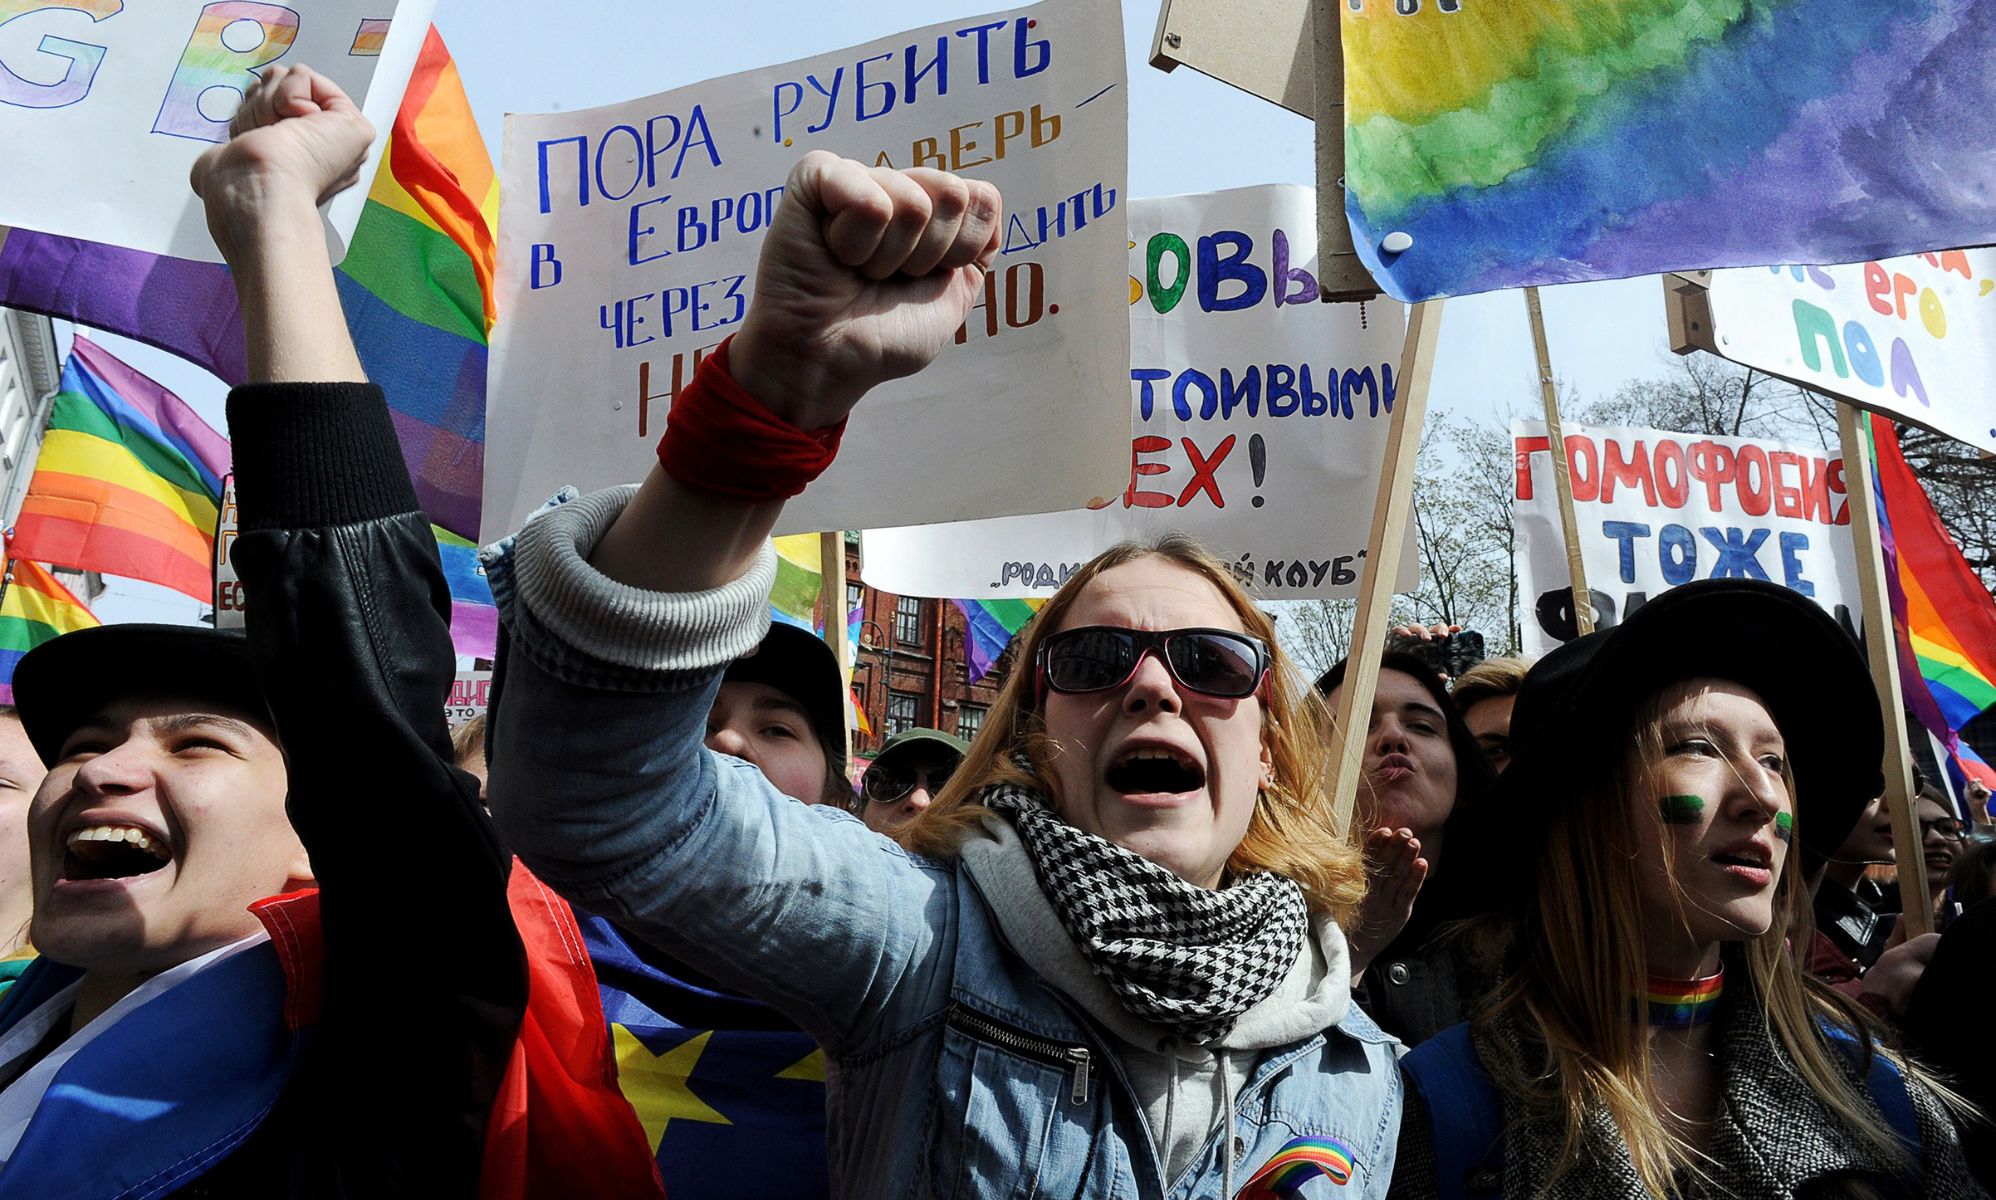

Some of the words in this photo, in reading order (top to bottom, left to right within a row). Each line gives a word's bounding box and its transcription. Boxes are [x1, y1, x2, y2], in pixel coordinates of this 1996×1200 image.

[538, 104, 721, 213] ПОРА
[773, 17, 1052, 143] РУБИТЬ
[875, 104, 1062, 173] ВЕРЬ
[600, 275, 745, 349] ЧЕРЕЗ
[1001, 182, 1117, 256] ДИТЬ
[1122, 434, 1267, 509] ЕХ!
[1602, 520, 1815, 597] ТОЖЕ
